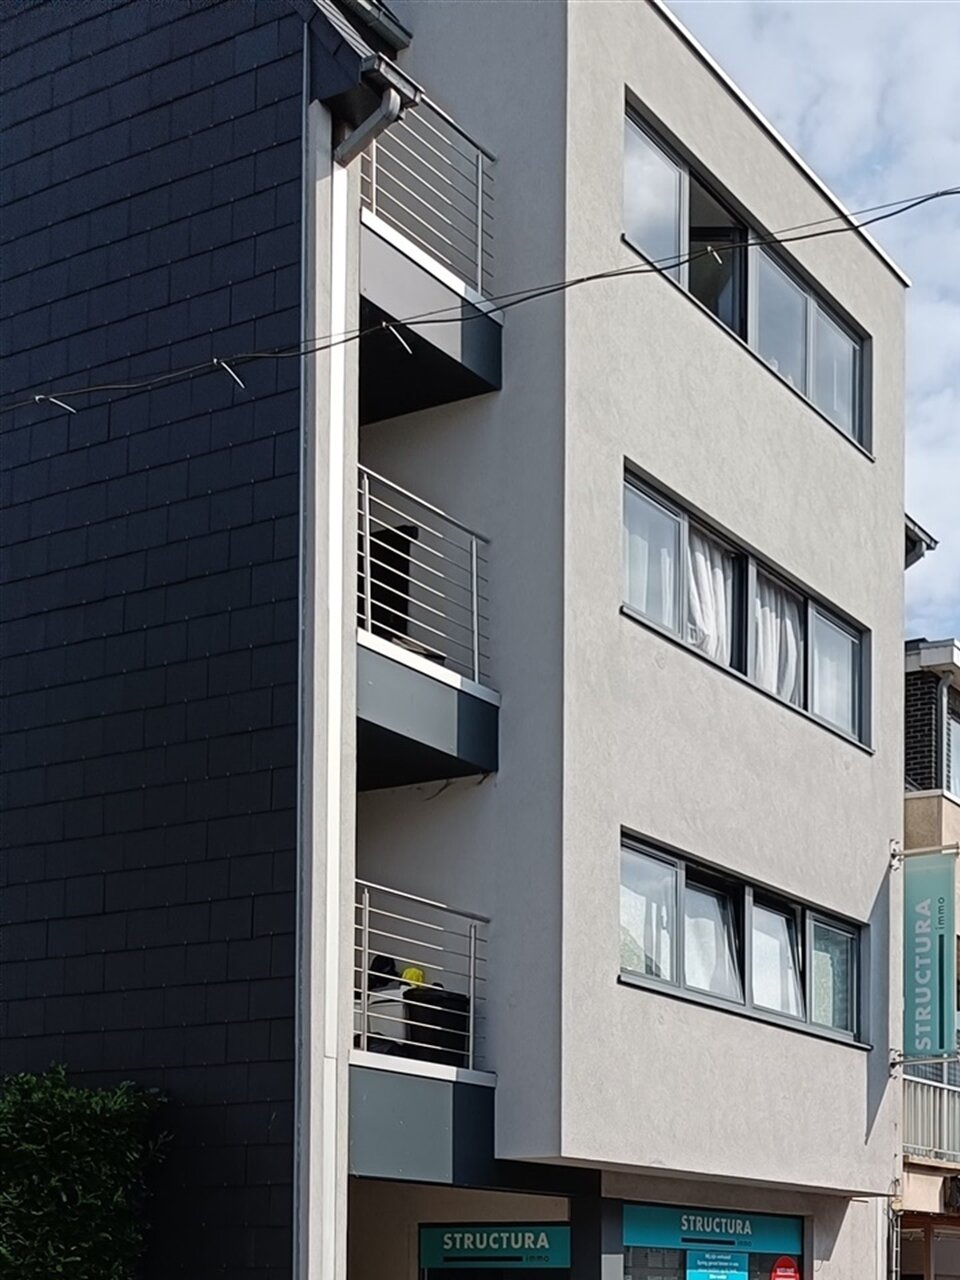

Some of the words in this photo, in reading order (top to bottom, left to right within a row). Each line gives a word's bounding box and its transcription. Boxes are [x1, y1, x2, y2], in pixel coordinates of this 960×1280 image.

[936, 896, 945, 930] immo
[915, 898, 932, 1050] STRUCTURA
[680, 1214, 752, 1235] STRUCTURA
[443, 1231, 550, 1249] STRUCTURA
